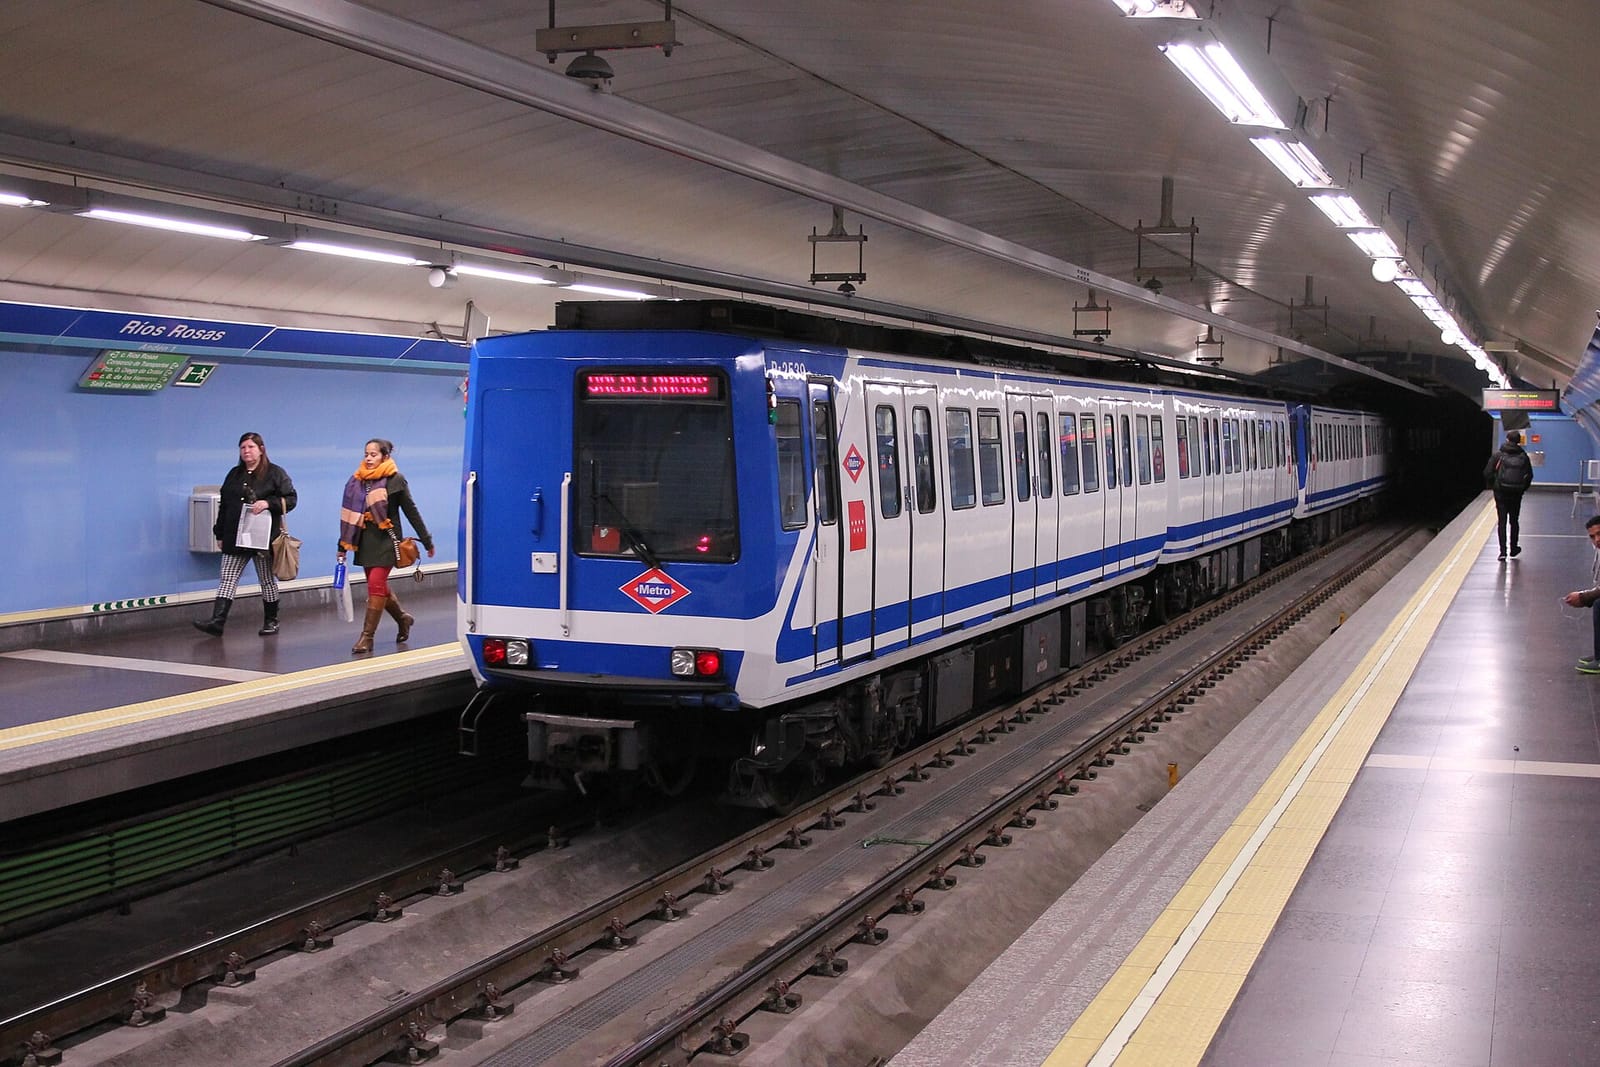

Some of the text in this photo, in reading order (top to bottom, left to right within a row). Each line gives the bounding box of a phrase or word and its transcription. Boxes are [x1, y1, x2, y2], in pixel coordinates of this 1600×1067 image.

[120, 320, 226, 341] Ríos Rosas
[639, 584, 671, 595] Metro
